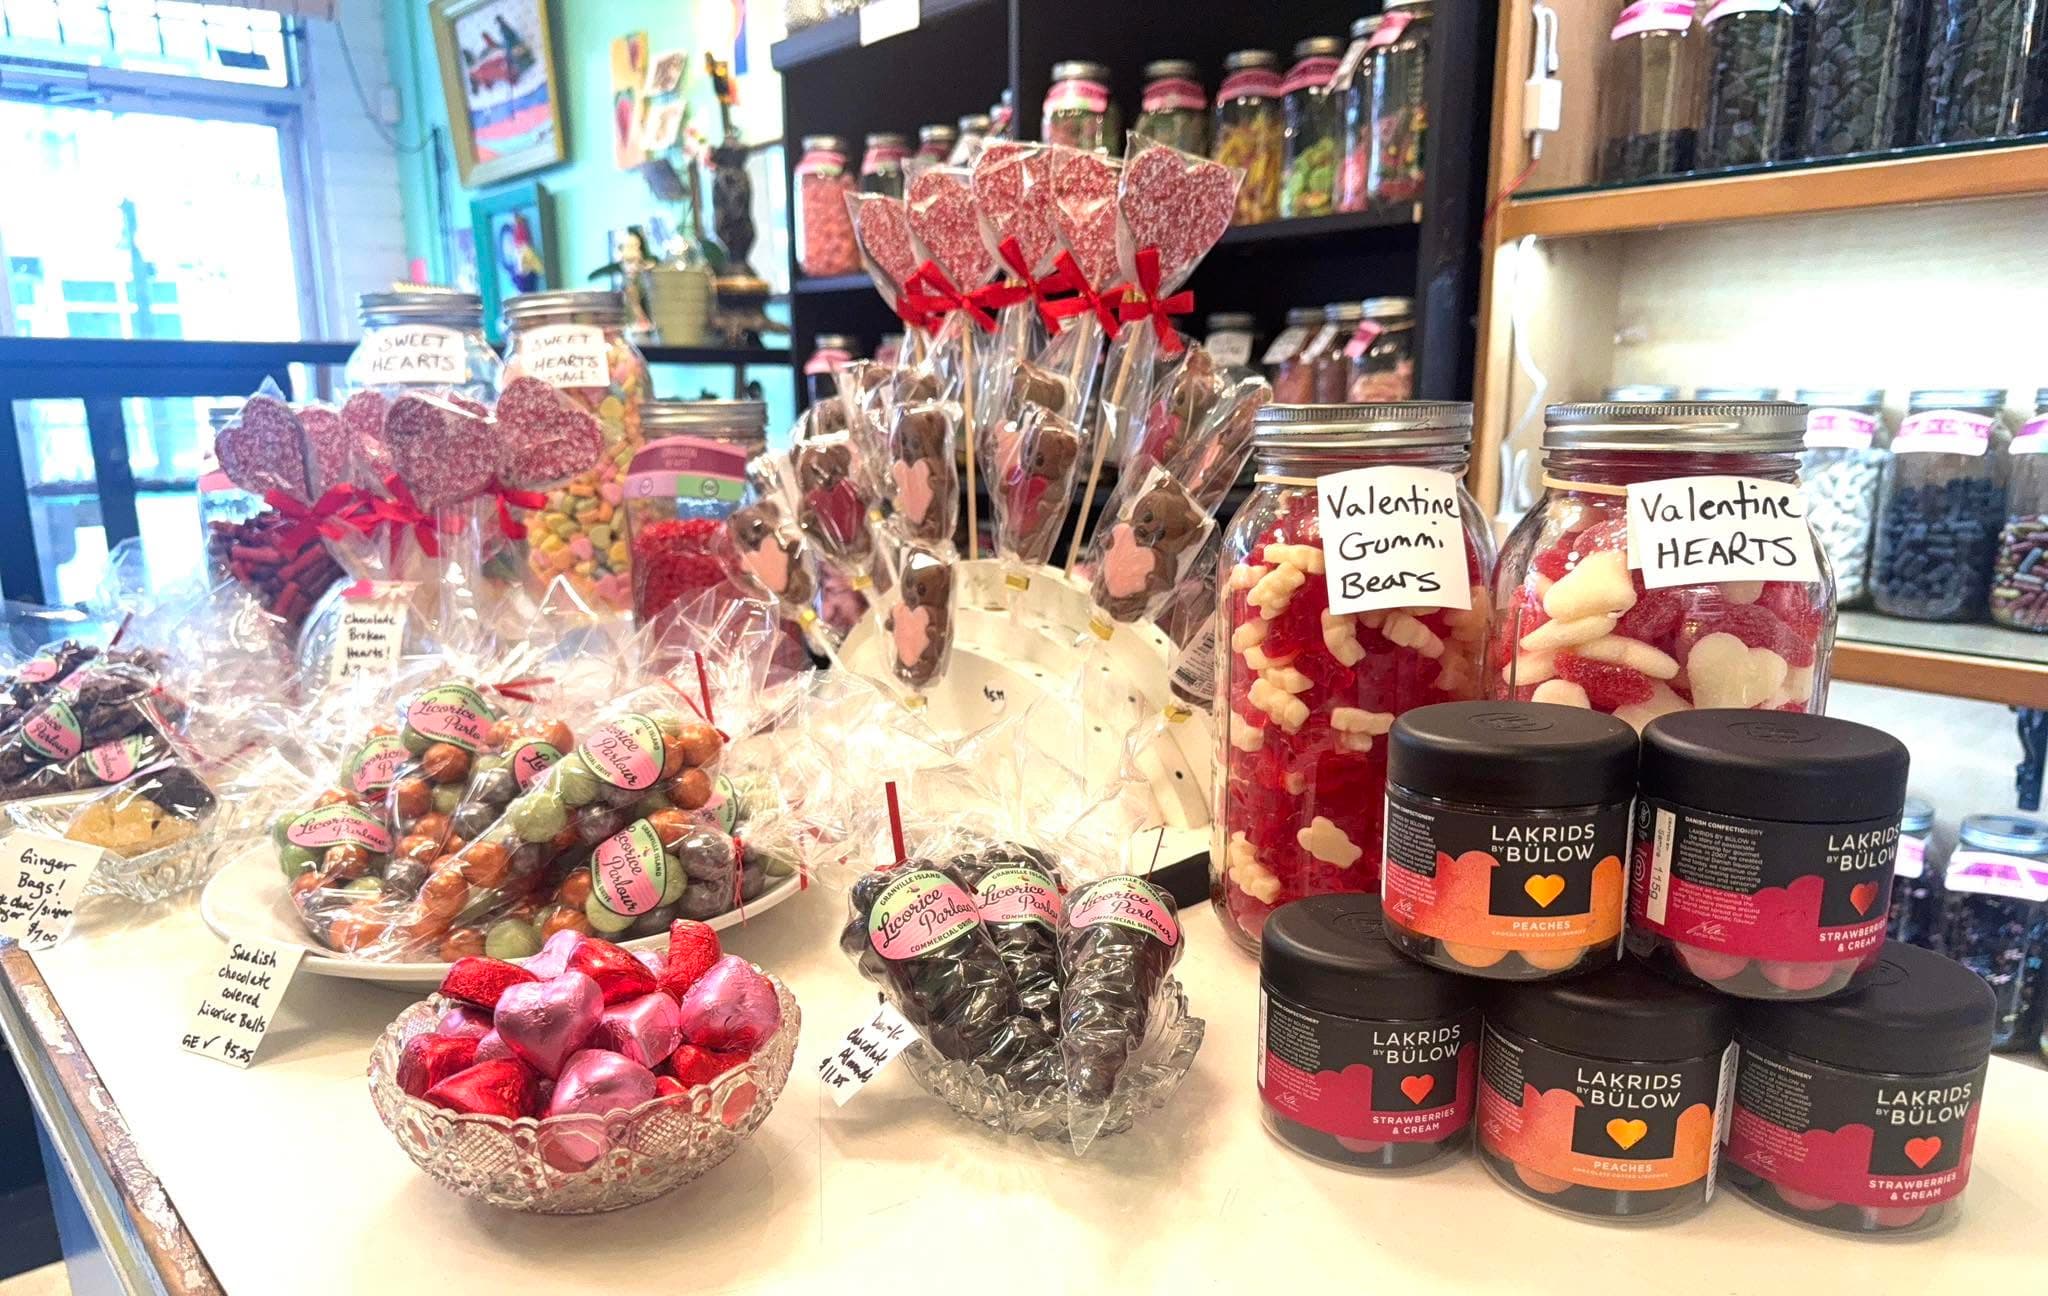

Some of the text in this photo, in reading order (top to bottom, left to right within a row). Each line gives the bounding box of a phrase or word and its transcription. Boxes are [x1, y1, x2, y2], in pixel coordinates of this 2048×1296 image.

[378, 332, 448, 351] SWEET
[371, 353, 455, 372] HEARTS
[534, 352, 599, 369] HEARTS
[1326, 482, 1460, 520] Valentine
[1641, 480, 1802, 523] Valentine
[1338, 521, 1444, 561] Gummi
[1658, 532, 1798, 569] HEARTS
[1340, 571, 1442, 600] Bears
[413, 697, 476, 721] Licorice
[443, 715, 481, 740] Parlo
[592, 737, 638, 786] Parlour
[296, 817, 363, 838] Licorice
[1492, 824, 1595, 844] LAKRIDS
[1685, 816, 1763, 836] DANISH CONFECTIONERY
[1828, 823, 1900, 852] LAKRIDS
[20, 848, 77, 874] Ginger
[1492, 843, 1595, 863] BY BÜLOW
[17, 872, 66, 899] Bags!
[602, 855, 638, 912] Parlour
[992, 869, 1028, 880] GRANVILLE
[1098, 876, 1137, 888] GRANVILLE
[880, 873, 941, 906] GRANVILLE ISLAND
[978, 882, 1046, 910] Licorice
[1075, 889, 1150, 919] Licorice
[877, 889, 943, 949] Licorice
[1111, 899, 1172, 942] Parlour
[1512, 921, 1571, 931] PEACHES
[910, 928, 959, 953] COMMERCIAL
[1837, 935, 1877, 952] & CREAM
[230, 943, 277, 968] Swedish
[218, 964, 271, 990] chocolate
[222, 988, 261, 1008] covered
[197, 1000, 237, 1023] Licorice
[1373, 1024, 1461, 1047] LAKRIDS
[224, 1039, 255, 1063] $5.25
[1386, 1041, 1460, 1064] BÜLOW
[1577, 1067, 1682, 1090] LAKRIDS
[1576, 1086, 1681, 1109] BY BÜLOW
[1877, 1082, 1972, 1106] LAKRIDS
[1372, 1107, 1455, 1125] STRAWBERRIES
[1876, 1101, 1970, 1126] BY BÜLOW
[1392, 1122, 1440, 1135] & CREAM
[1594, 1161, 1652, 1173] PEACHES
[1868, 1172, 1957, 1190] STRAWBERRIES
[1890, 1188, 1941, 1201] & CREAM
